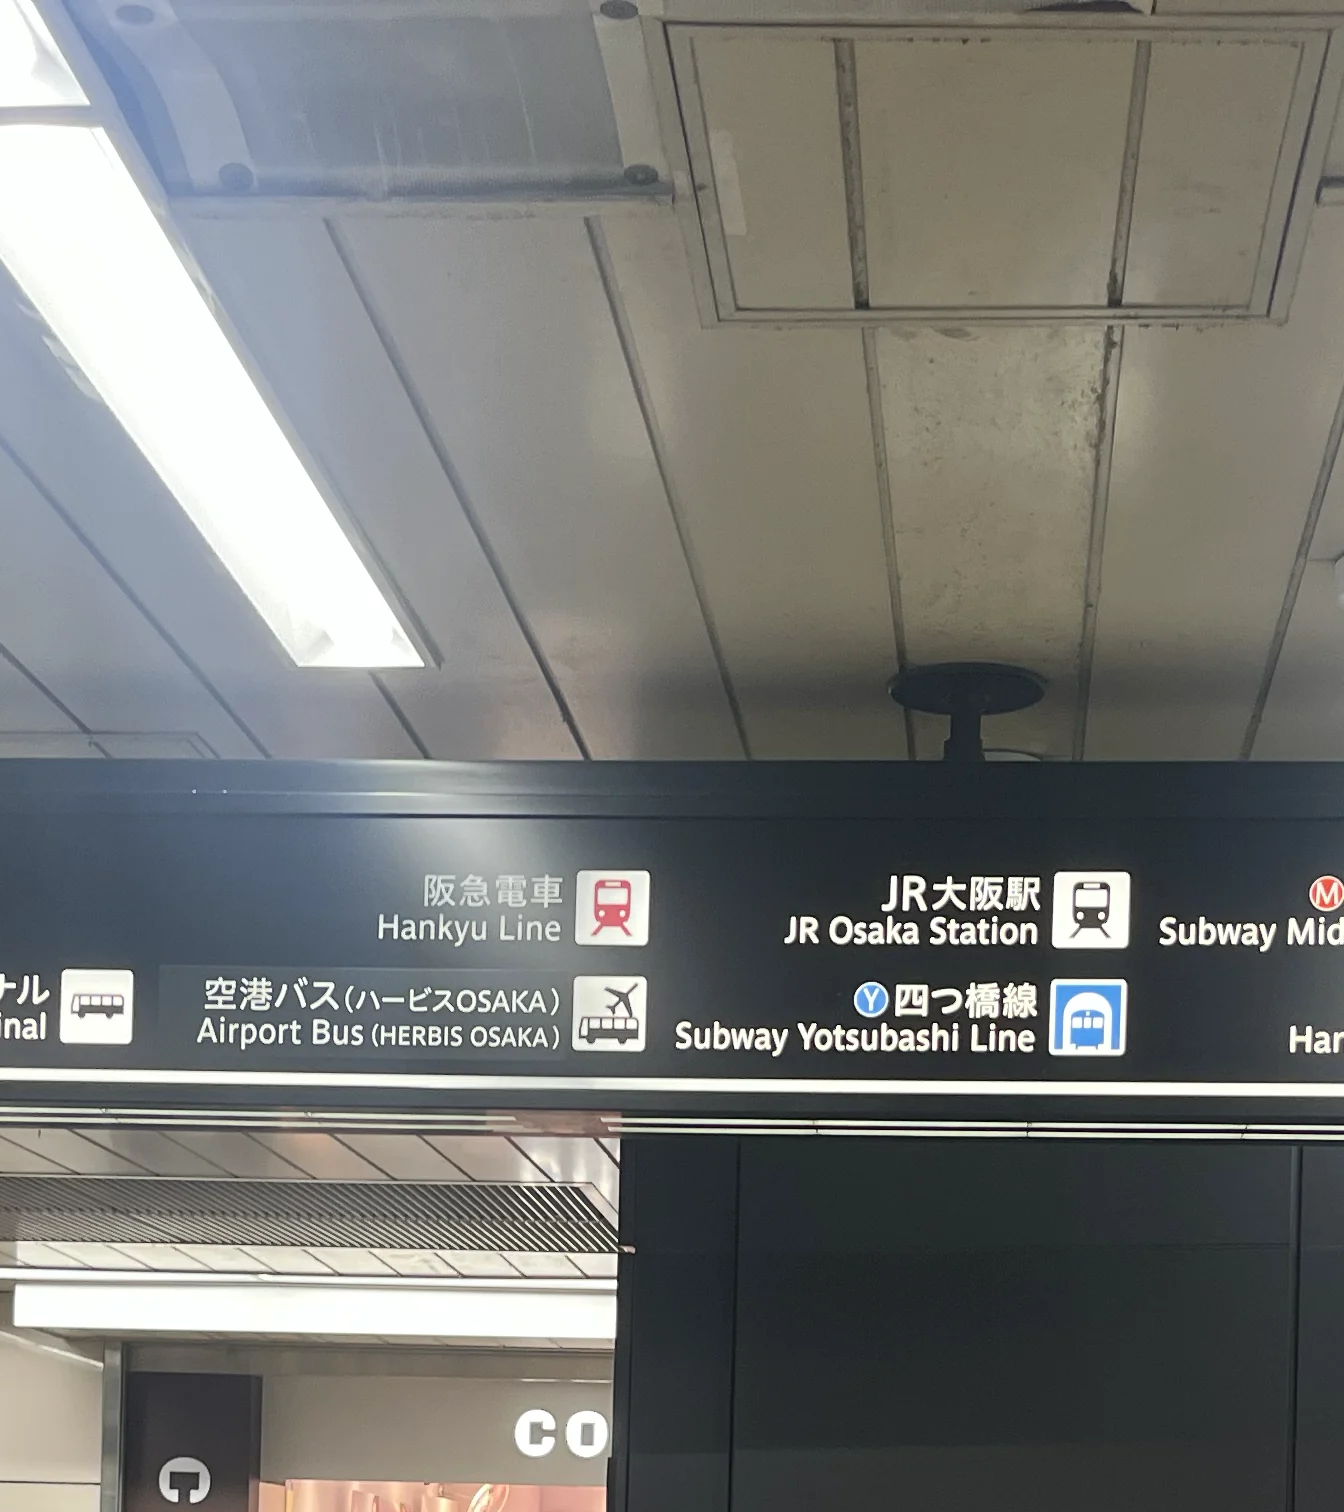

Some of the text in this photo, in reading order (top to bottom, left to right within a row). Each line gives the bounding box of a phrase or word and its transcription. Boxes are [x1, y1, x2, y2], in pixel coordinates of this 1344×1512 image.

[423, 873, 564, 909] 阪急電車
[881, 875, 1041, 912] JR大阪駅
[378, 913, 561, 947] Hankyu Line
[783, 915, 1038, 946] JR Osaka Station
[1159, 916, 1277, 953] Subway
[894, 982, 1038, 1019] 四つ橋線
[196, 1016, 560, 1050] Airport Bus (HERBIS OSAKA)
[675, 1020, 1036, 1057] Subway Yotsubashi Line
[514, 1409, 609, 1458] CO
